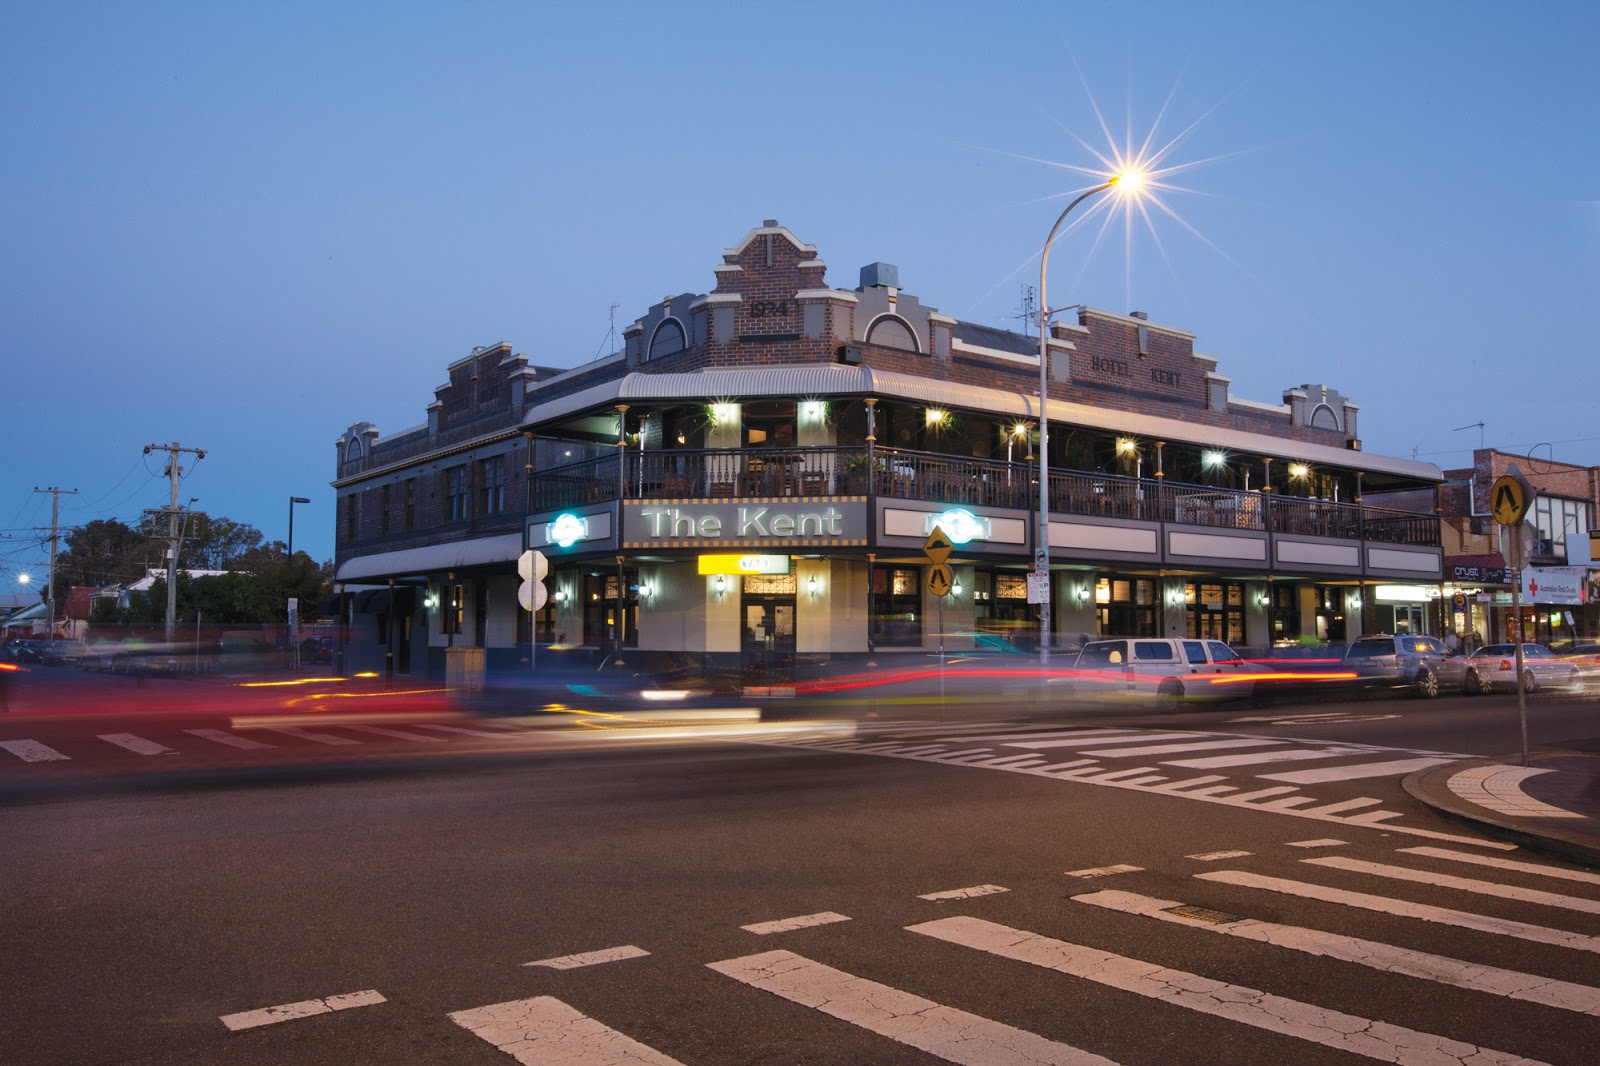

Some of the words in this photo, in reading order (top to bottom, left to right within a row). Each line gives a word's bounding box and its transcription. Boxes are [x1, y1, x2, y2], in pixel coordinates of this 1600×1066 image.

[1092, 355, 1132, 377] HOTEL
[1151, 367, 1181, 386] KENT
[641, 508, 721, 538] The
[737, 507, 842, 537] Kent
[1454, 566, 1479, 576] crust
